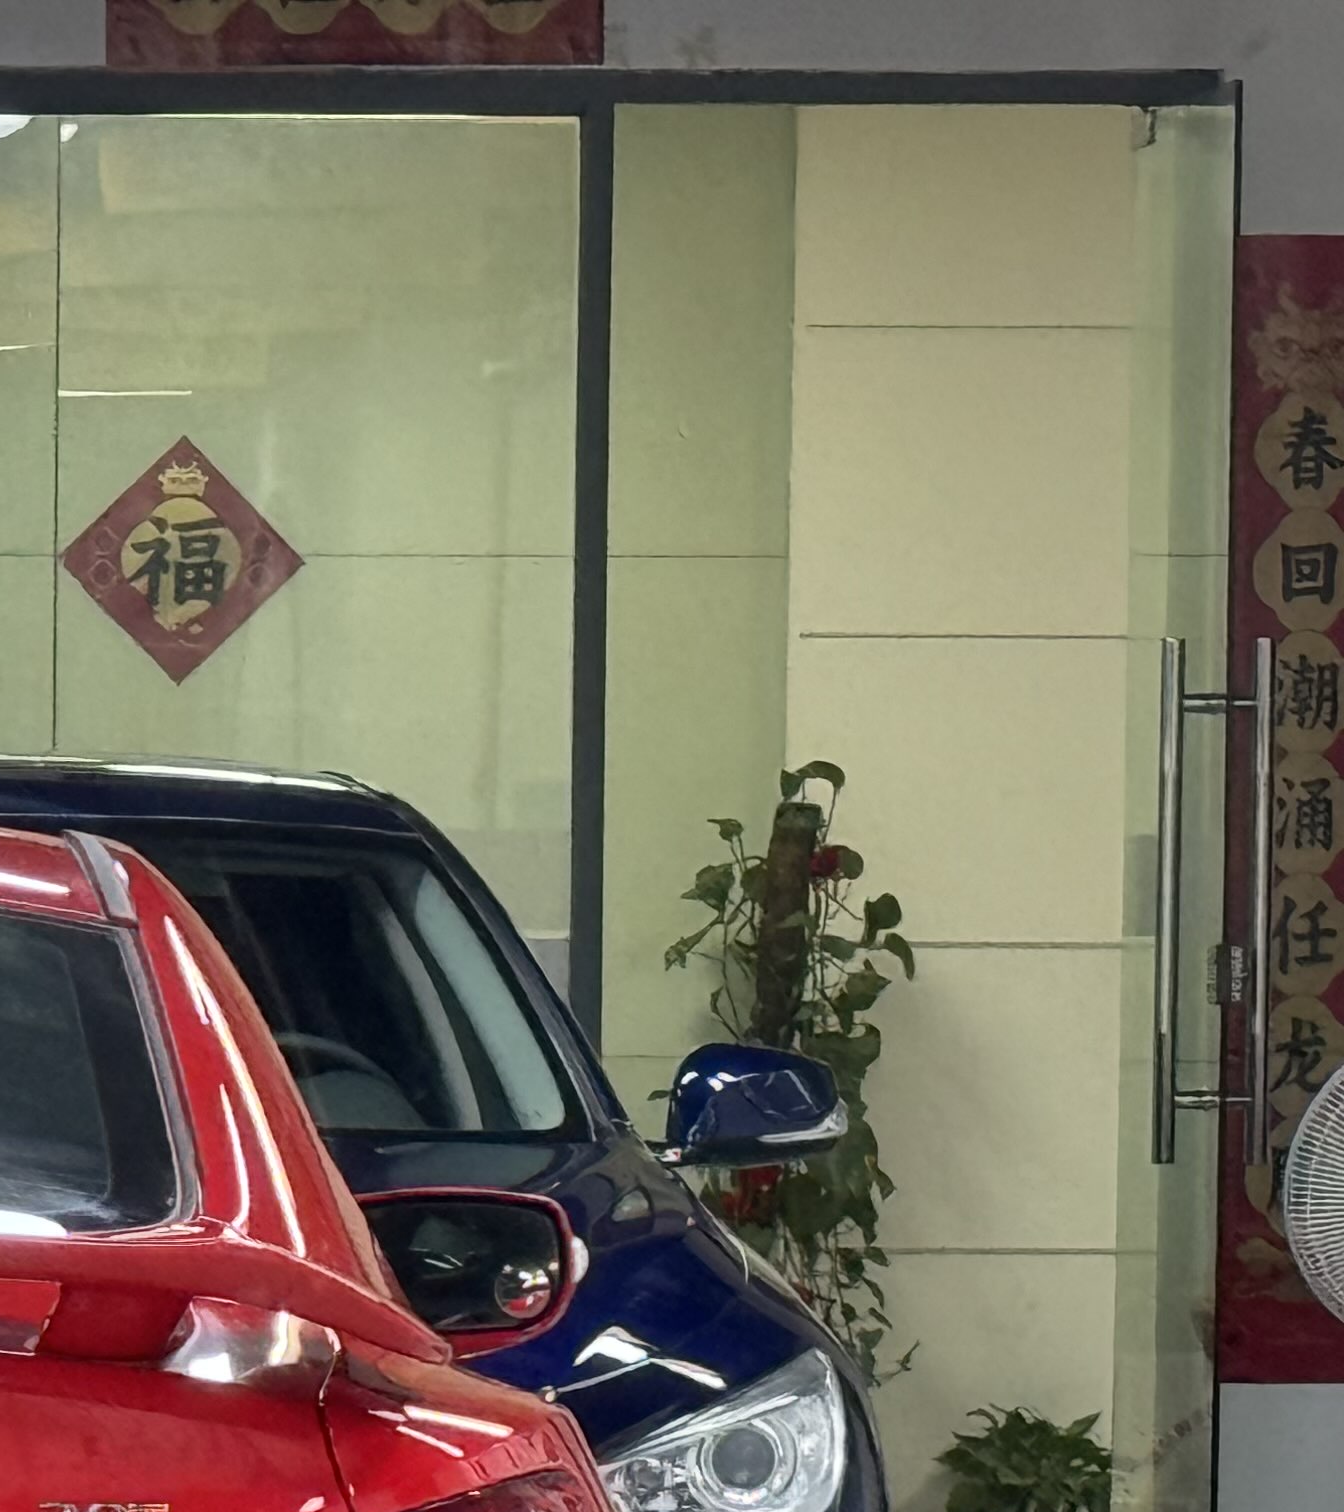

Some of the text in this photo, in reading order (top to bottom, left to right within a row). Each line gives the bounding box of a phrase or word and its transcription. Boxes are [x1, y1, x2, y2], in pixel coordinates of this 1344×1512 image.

[129, 516, 228, 606] 福
[1273, 406, 1344, 1212] 春回潮涌任龙
